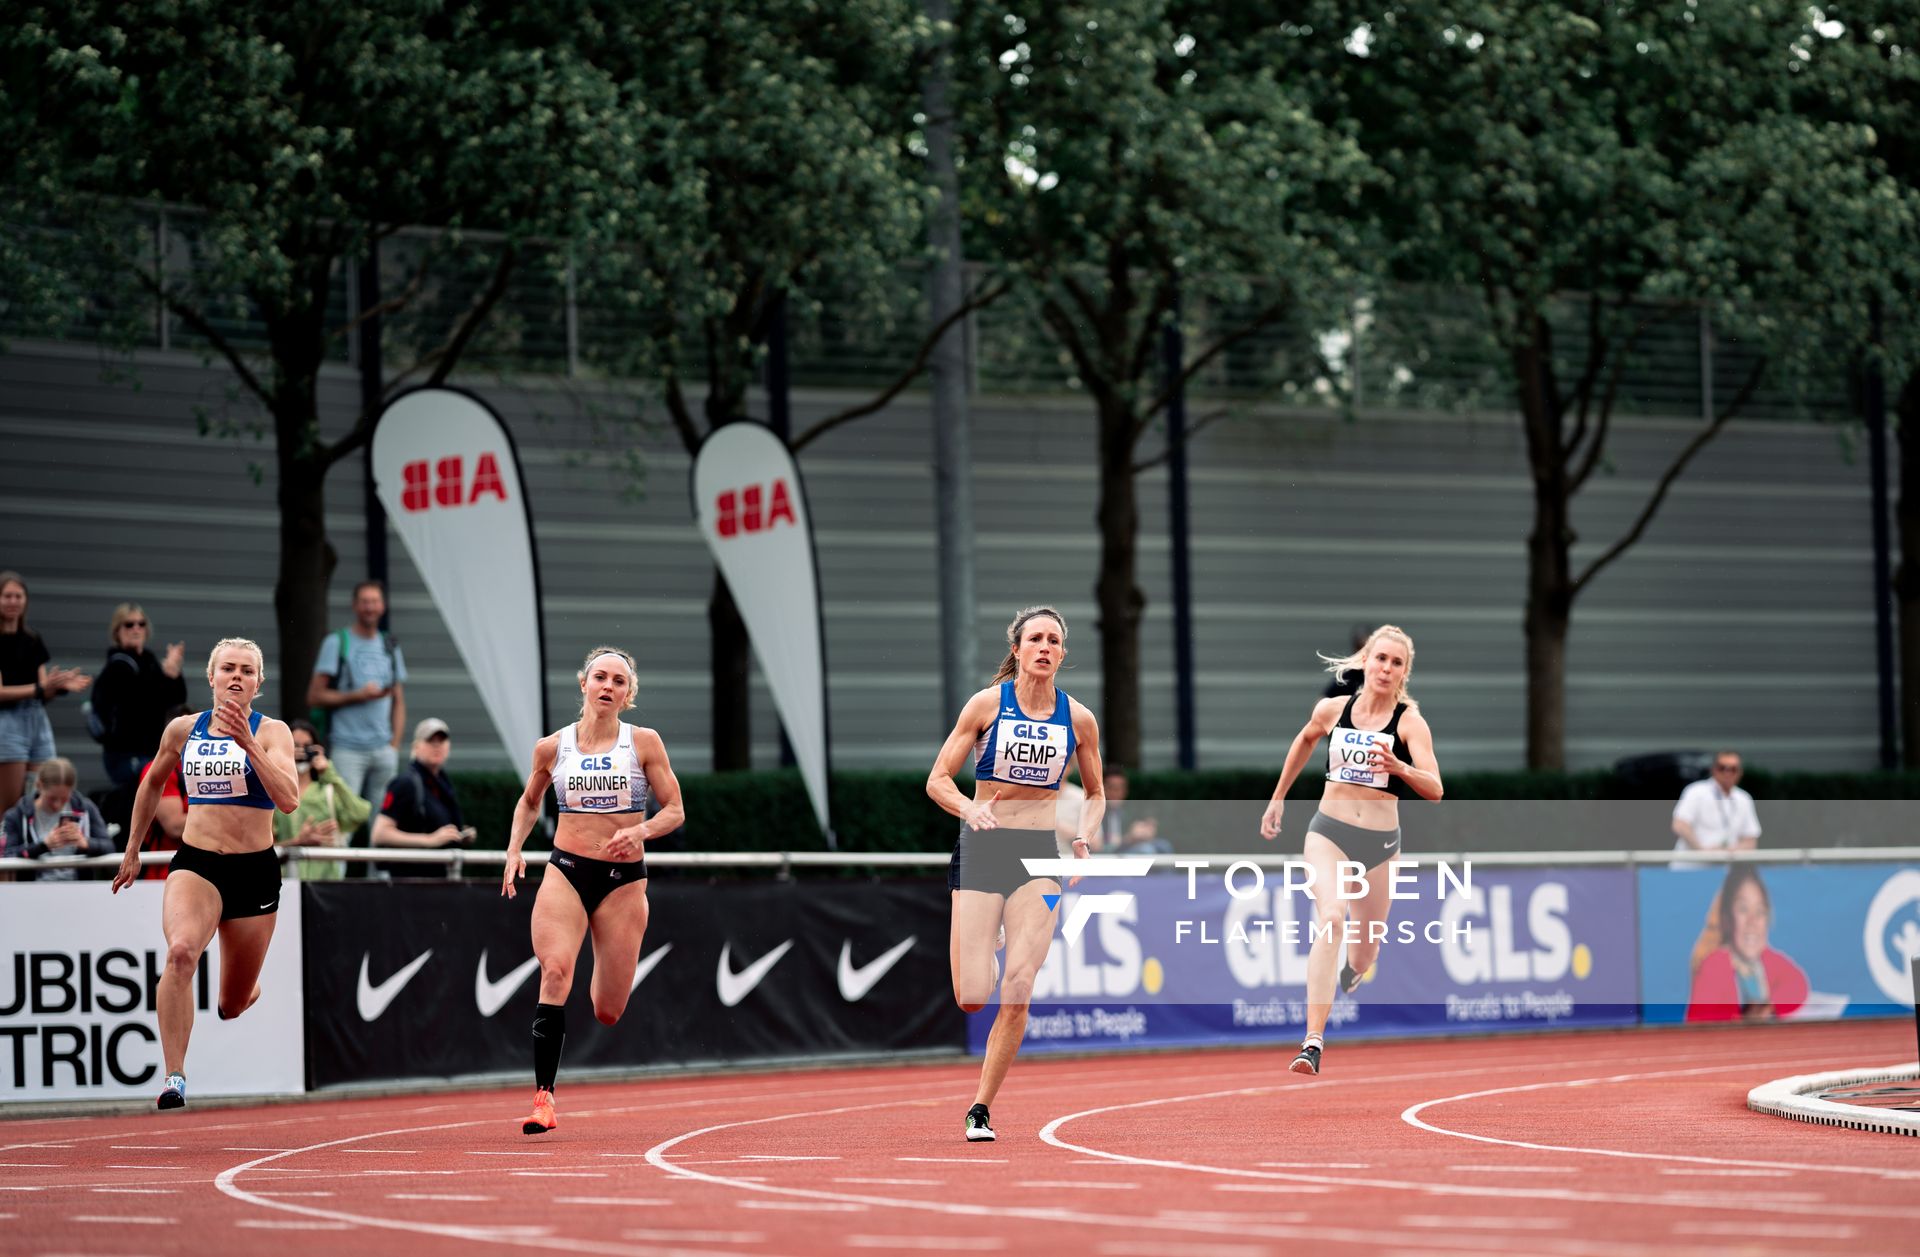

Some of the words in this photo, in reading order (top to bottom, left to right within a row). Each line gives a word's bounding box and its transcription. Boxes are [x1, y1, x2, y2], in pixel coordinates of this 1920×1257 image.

[1004, 741, 1057, 765] KEMP
[186, 762, 201, 776] DE
[205, 761, 241, 776] BOER
[1025, 768, 1048, 777] PLAN
[1353, 771, 1373, 779] PLAN
[569, 776, 627, 790] BRUNNER
[596, 797, 616, 805] PLAN
[1446, 993, 1501, 1021] Parcels
[1503, 992, 1520, 1019] to
[1522, 989, 1574, 1023] People
